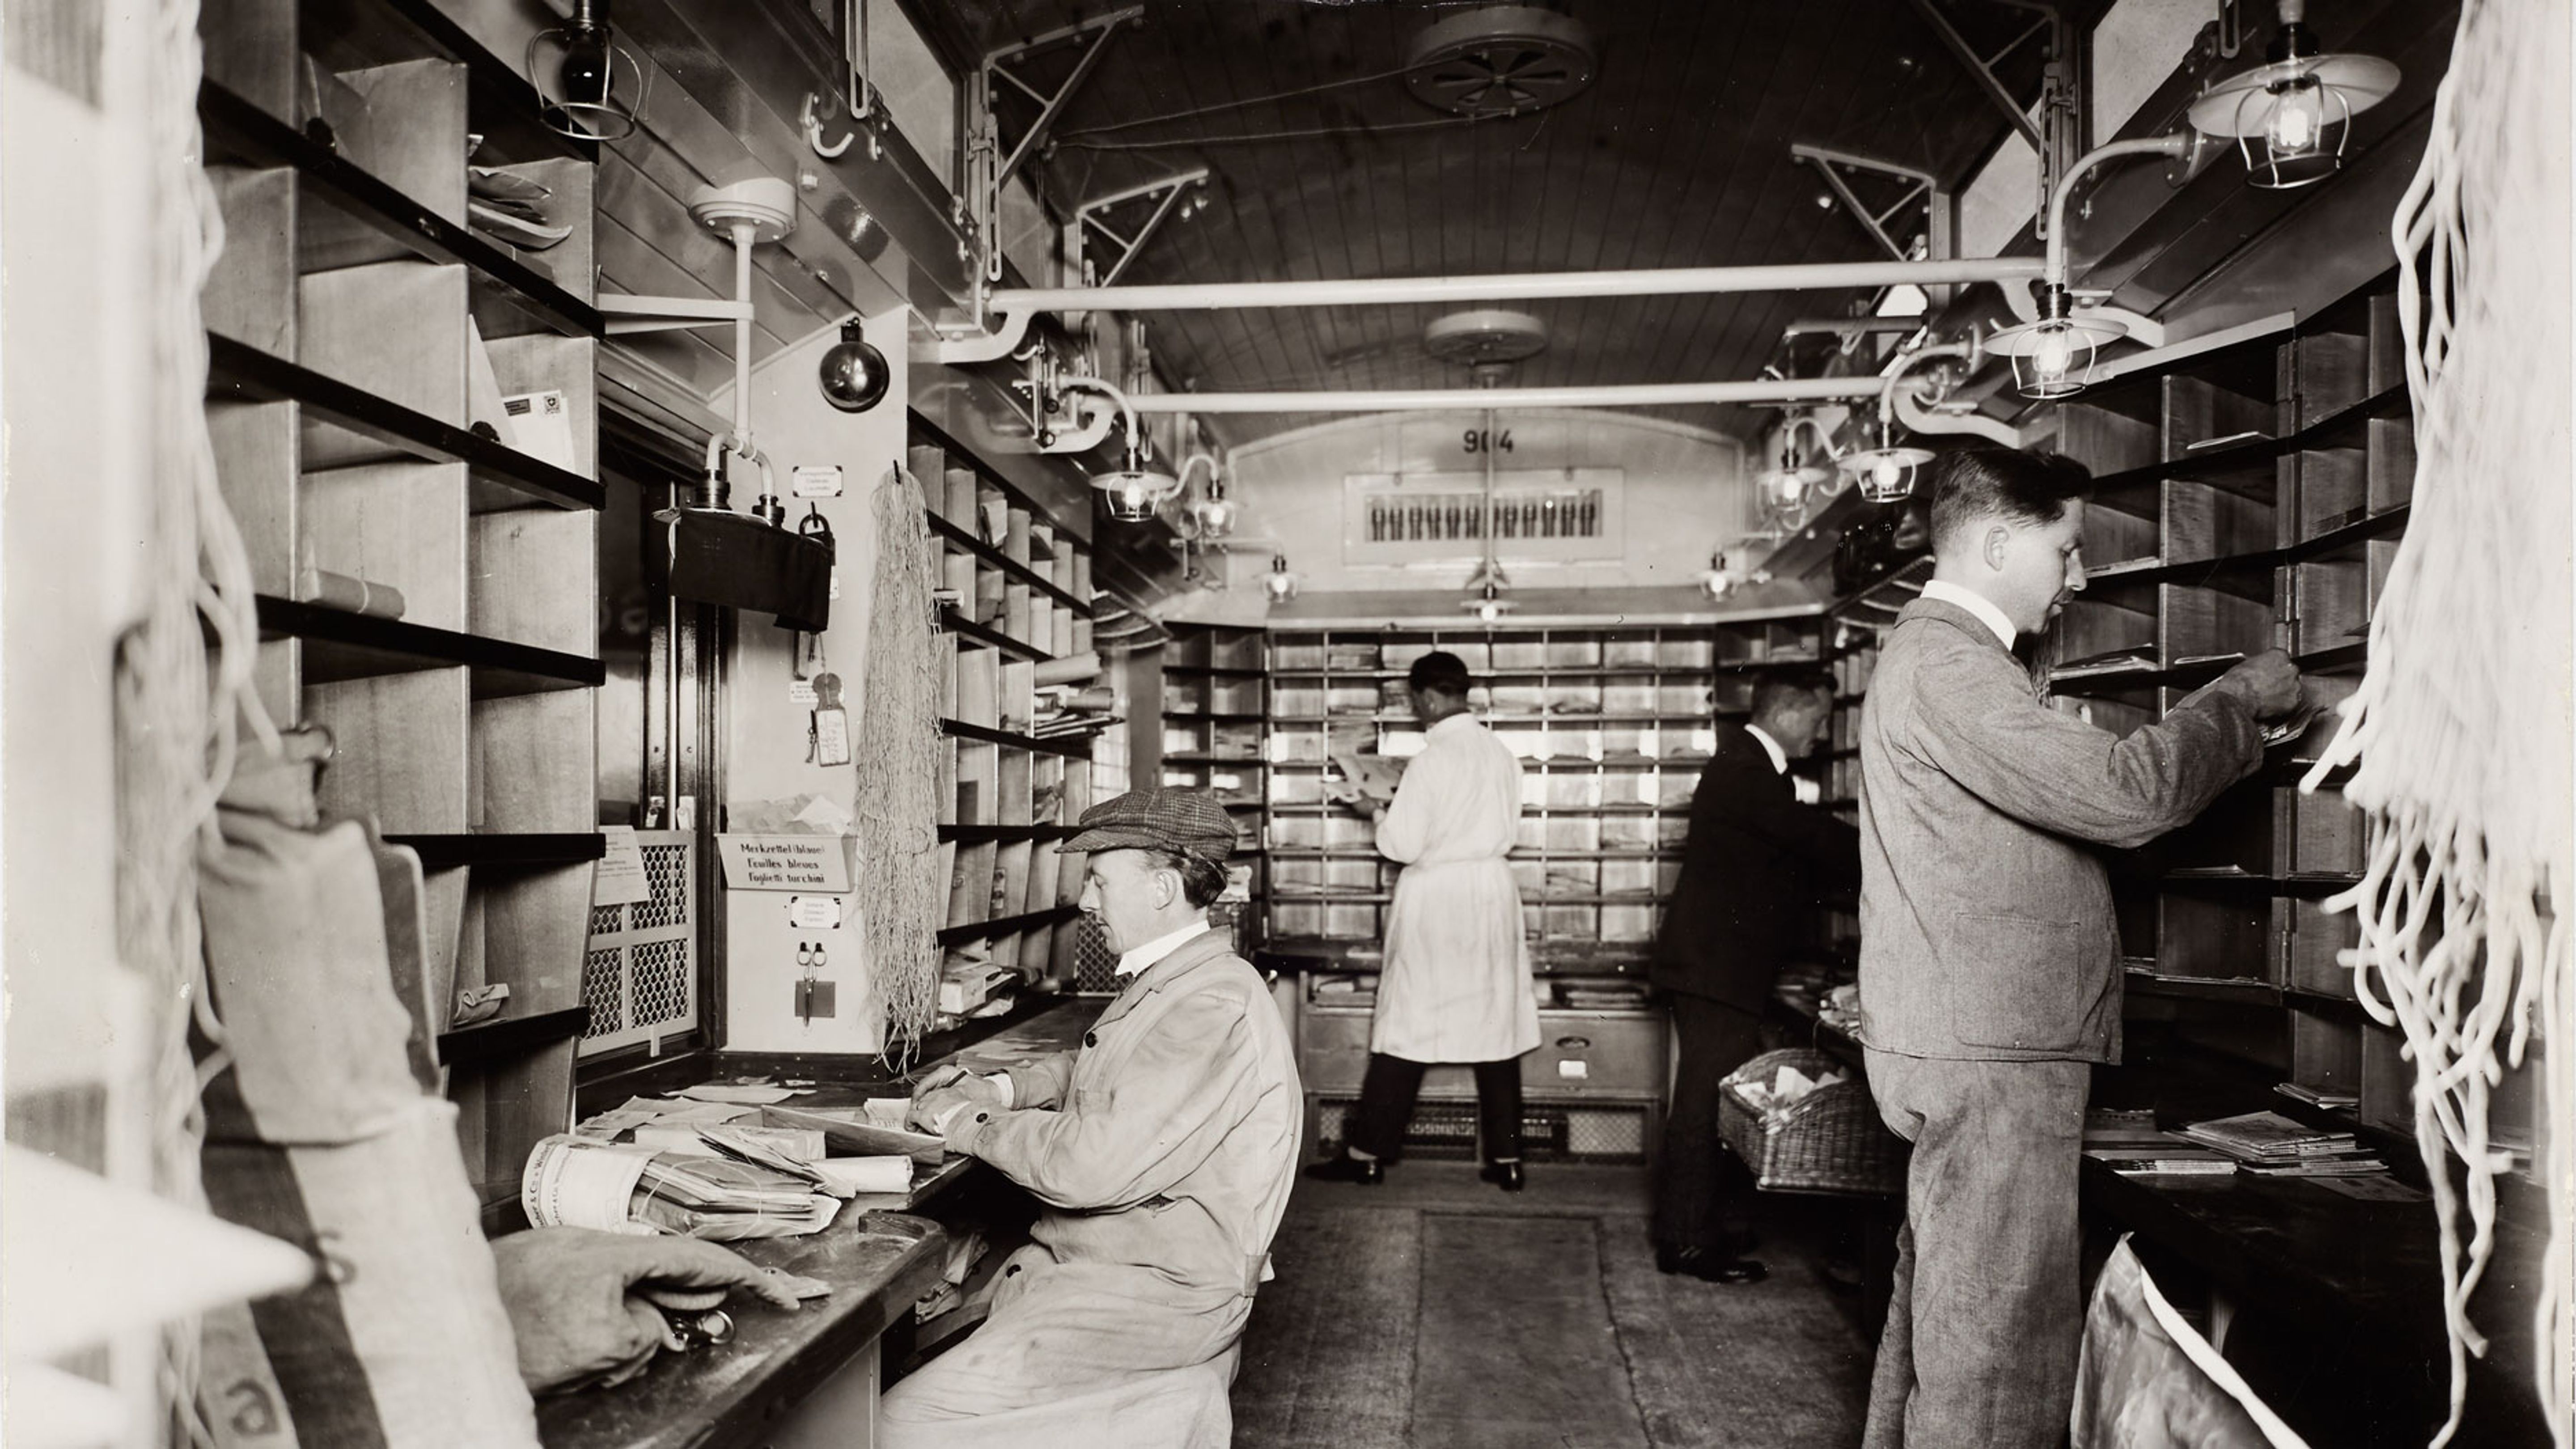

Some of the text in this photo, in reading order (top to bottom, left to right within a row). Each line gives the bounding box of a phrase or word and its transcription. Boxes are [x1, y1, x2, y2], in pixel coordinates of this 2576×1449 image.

[1464, 430, 1513, 453] 904
[747, 858, 819, 869] Feuilles bleues
[787, 873, 825, 883] turchini
